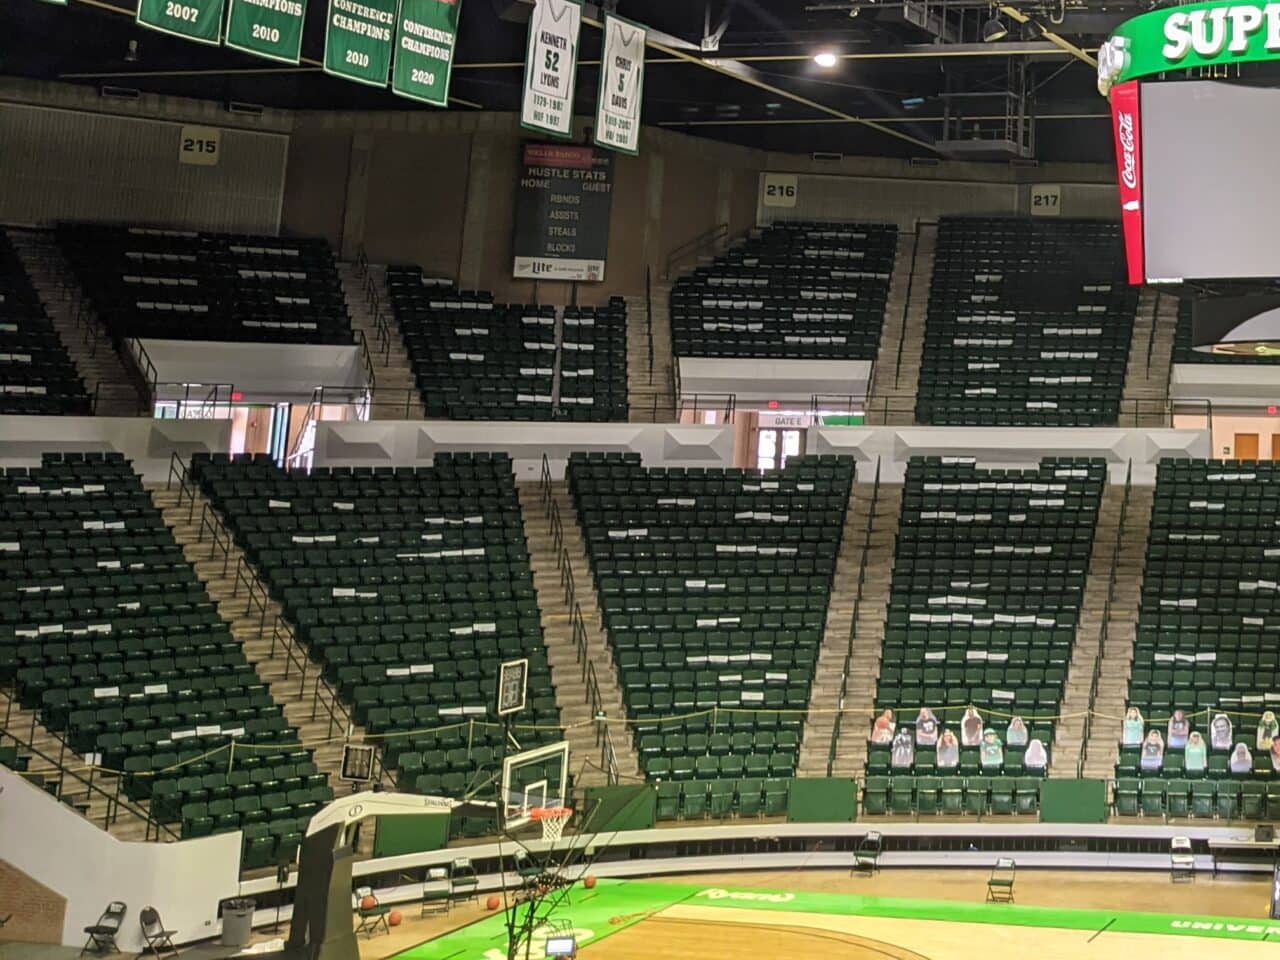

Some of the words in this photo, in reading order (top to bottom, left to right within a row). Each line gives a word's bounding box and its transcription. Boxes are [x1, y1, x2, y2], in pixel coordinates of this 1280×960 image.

[166, 1, 199, 23] 2007
[252, 24, 280, 43] 2010
[332, 13, 391, 41] CHAMPIONS
[401, 36, 450, 62] CHAMPIONS
[540, 30, 567, 51] KENNETH
[345, 50, 369, 68] 2010
[544, 49, 560, 73] 52
[411, 68, 435, 86] 2020
[540, 74, 560, 89] LYONS
[617, 73, 625, 93] 5
[611, 94, 628, 110] DAVIS
[184, 139, 216, 153] 215
[1118, 110, 1137, 189] Coca-Cola
[528, 167, 569, 179] HUSTLE
[572, 168, 606, 180] STATS
[521, 178, 552, 189] HOME
[582, 182, 612, 193] GUEST
[767, 185, 794, 197] 216
[1034, 195, 1058, 206] 217
[548, 226, 577, 237] STEALS
[775, 417, 792, 425] GATE
